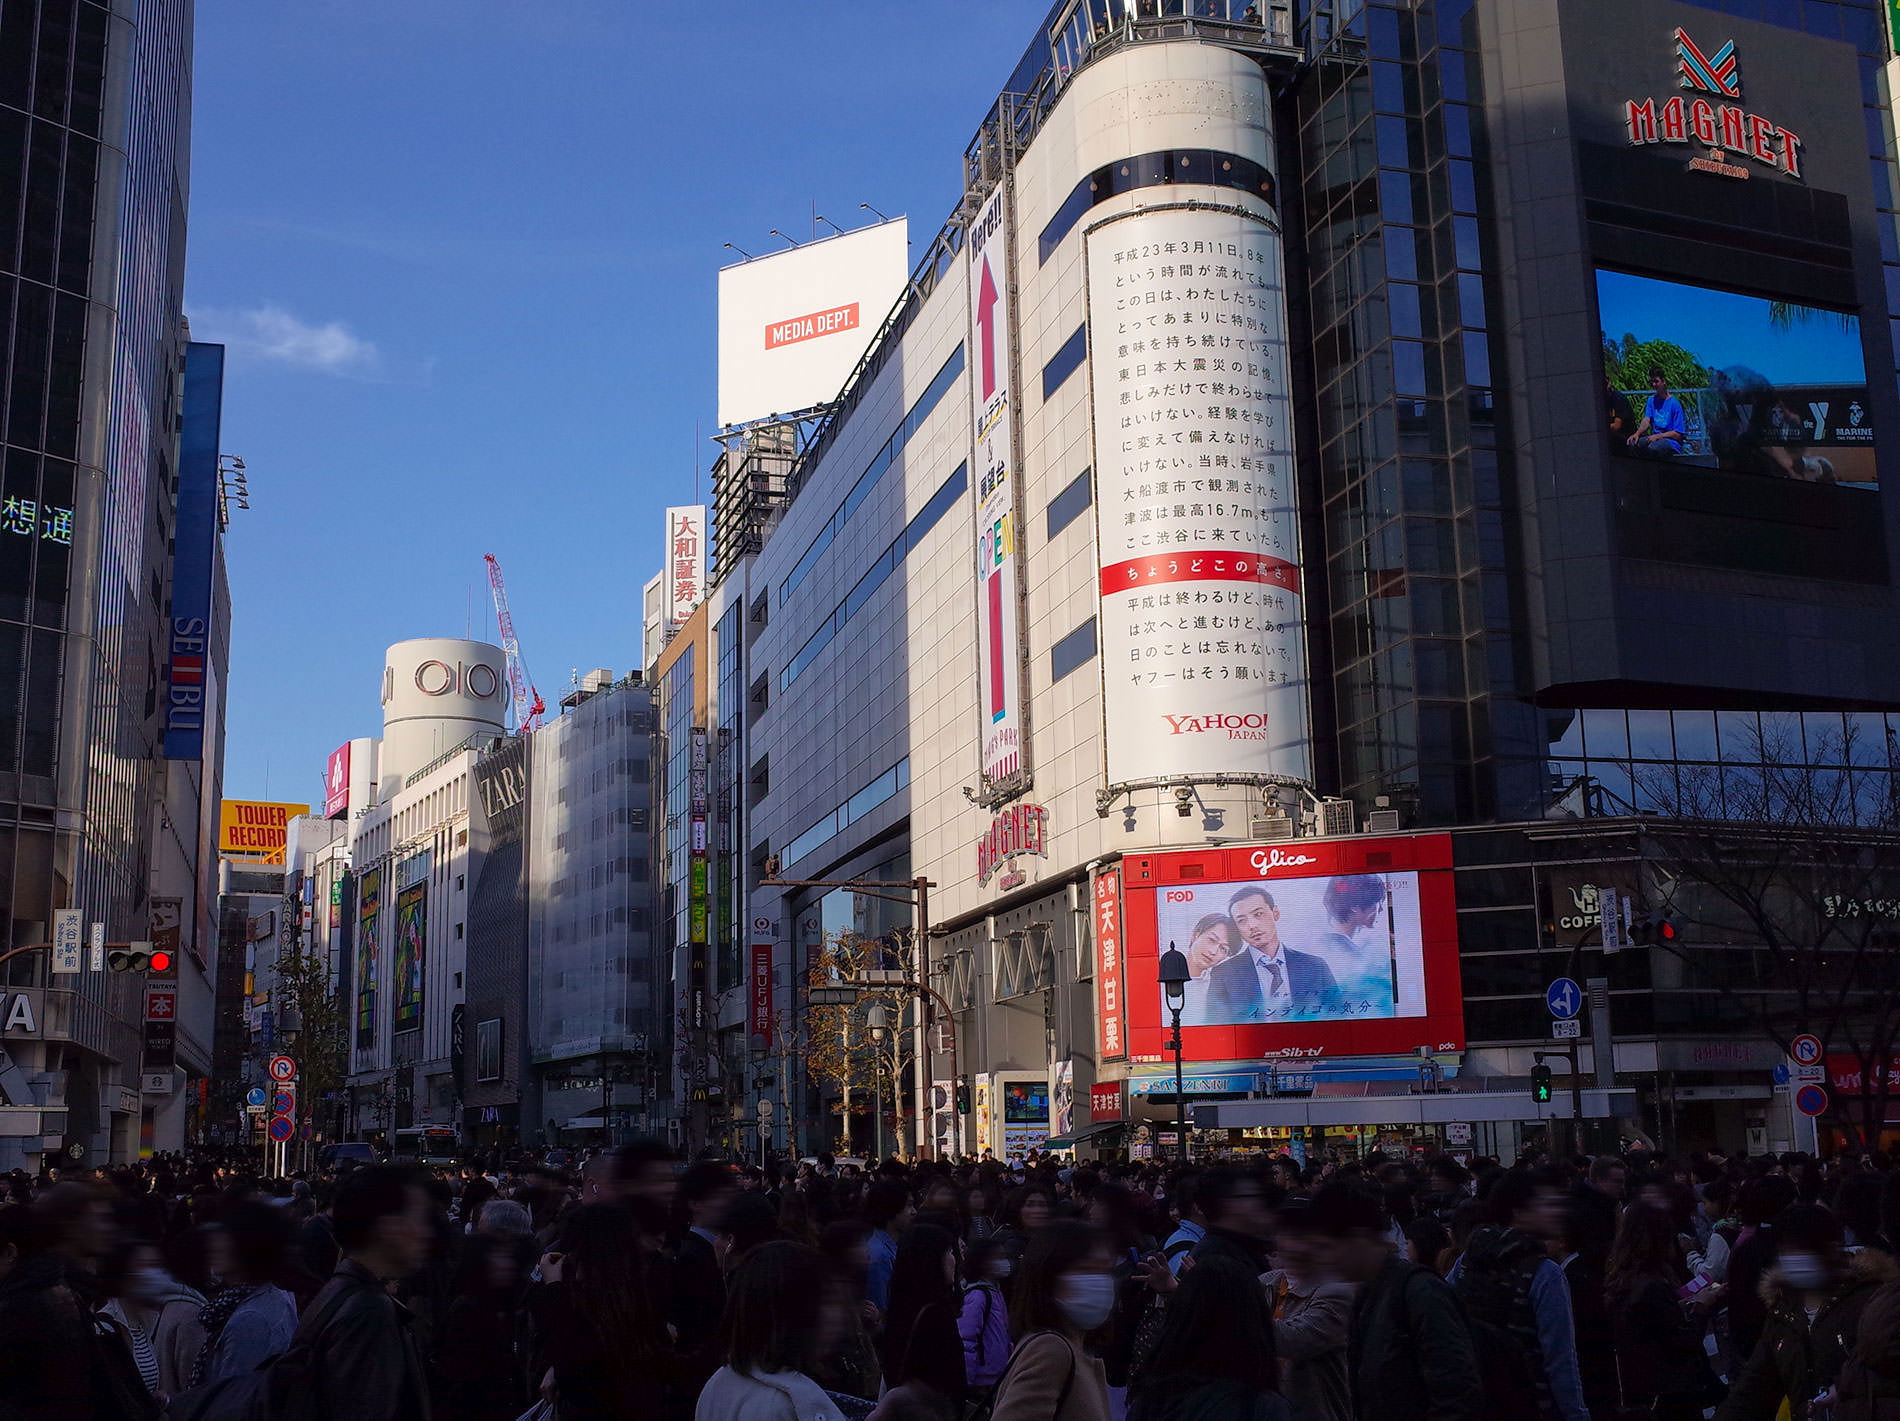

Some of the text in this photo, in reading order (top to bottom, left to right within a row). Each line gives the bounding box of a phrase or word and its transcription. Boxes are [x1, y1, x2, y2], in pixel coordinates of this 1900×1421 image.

[1626, 97, 1800, 178] MAGNET
[1113, 241, 1265, 265] 平成23年3月11日。8年
[1117, 288, 1267, 311] この日は、わたしたちに
[773, 308, 854, 345] MEDIA DEPT.
[1118, 312, 1268, 335] とってあまりに特別な
[1119, 382, 1273, 405] 悲しみだけで終わらせて
[1121, 406, 1274, 429] はいけない。経験を学び
[1122, 430, 1275, 452] に変えて備えなければ
[1123, 455, 1277, 477] いけない。当時、岩手県
[979, 459, 1005, 503] 展望台
[1123, 478, 1279, 502] 大船渡市で観測された
[1124, 504, 1280, 526] 津波は最高16.7m。もし
[979, 508, 1014, 582] OPEN
[1126, 528, 1285, 551] ここ渋谷に来ていたら、
[674, 516, 697, 602] 大和証券
[1127, 559, 1287, 583] ちょうどこの高さ。
[1127, 590, 1285, 612] 平成は終わるけど、時代
[1128, 616, 1285, 637] は次へと進むけど、あの
[1130, 641, 1291, 663] 日のことは忘れないで。
[169, 617, 204, 730] SEIBU
[1161, 713, 1269, 735] YAHOO!
[1227, 729, 1266, 741] JAPAN
[235, 805, 287, 826] TOWER
[977, 804, 1047, 883] MAGNET
[1250, 849, 1316, 875] Glico
[1166, 890, 1194, 903] FOD
[64, 914, 78, 968] 渋谷駅前
[1101, 902, 1118, 1051] 天津甘栗
[756, 953, 769, 1030] 三菱UFJ銀行
[0, 992, 36, 1033] A
[151, 996, 172, 1016] 本
[1092, 1093, 1121, 1113] 天津甘栗
[480, 1107, 499, 1123] ZARA
